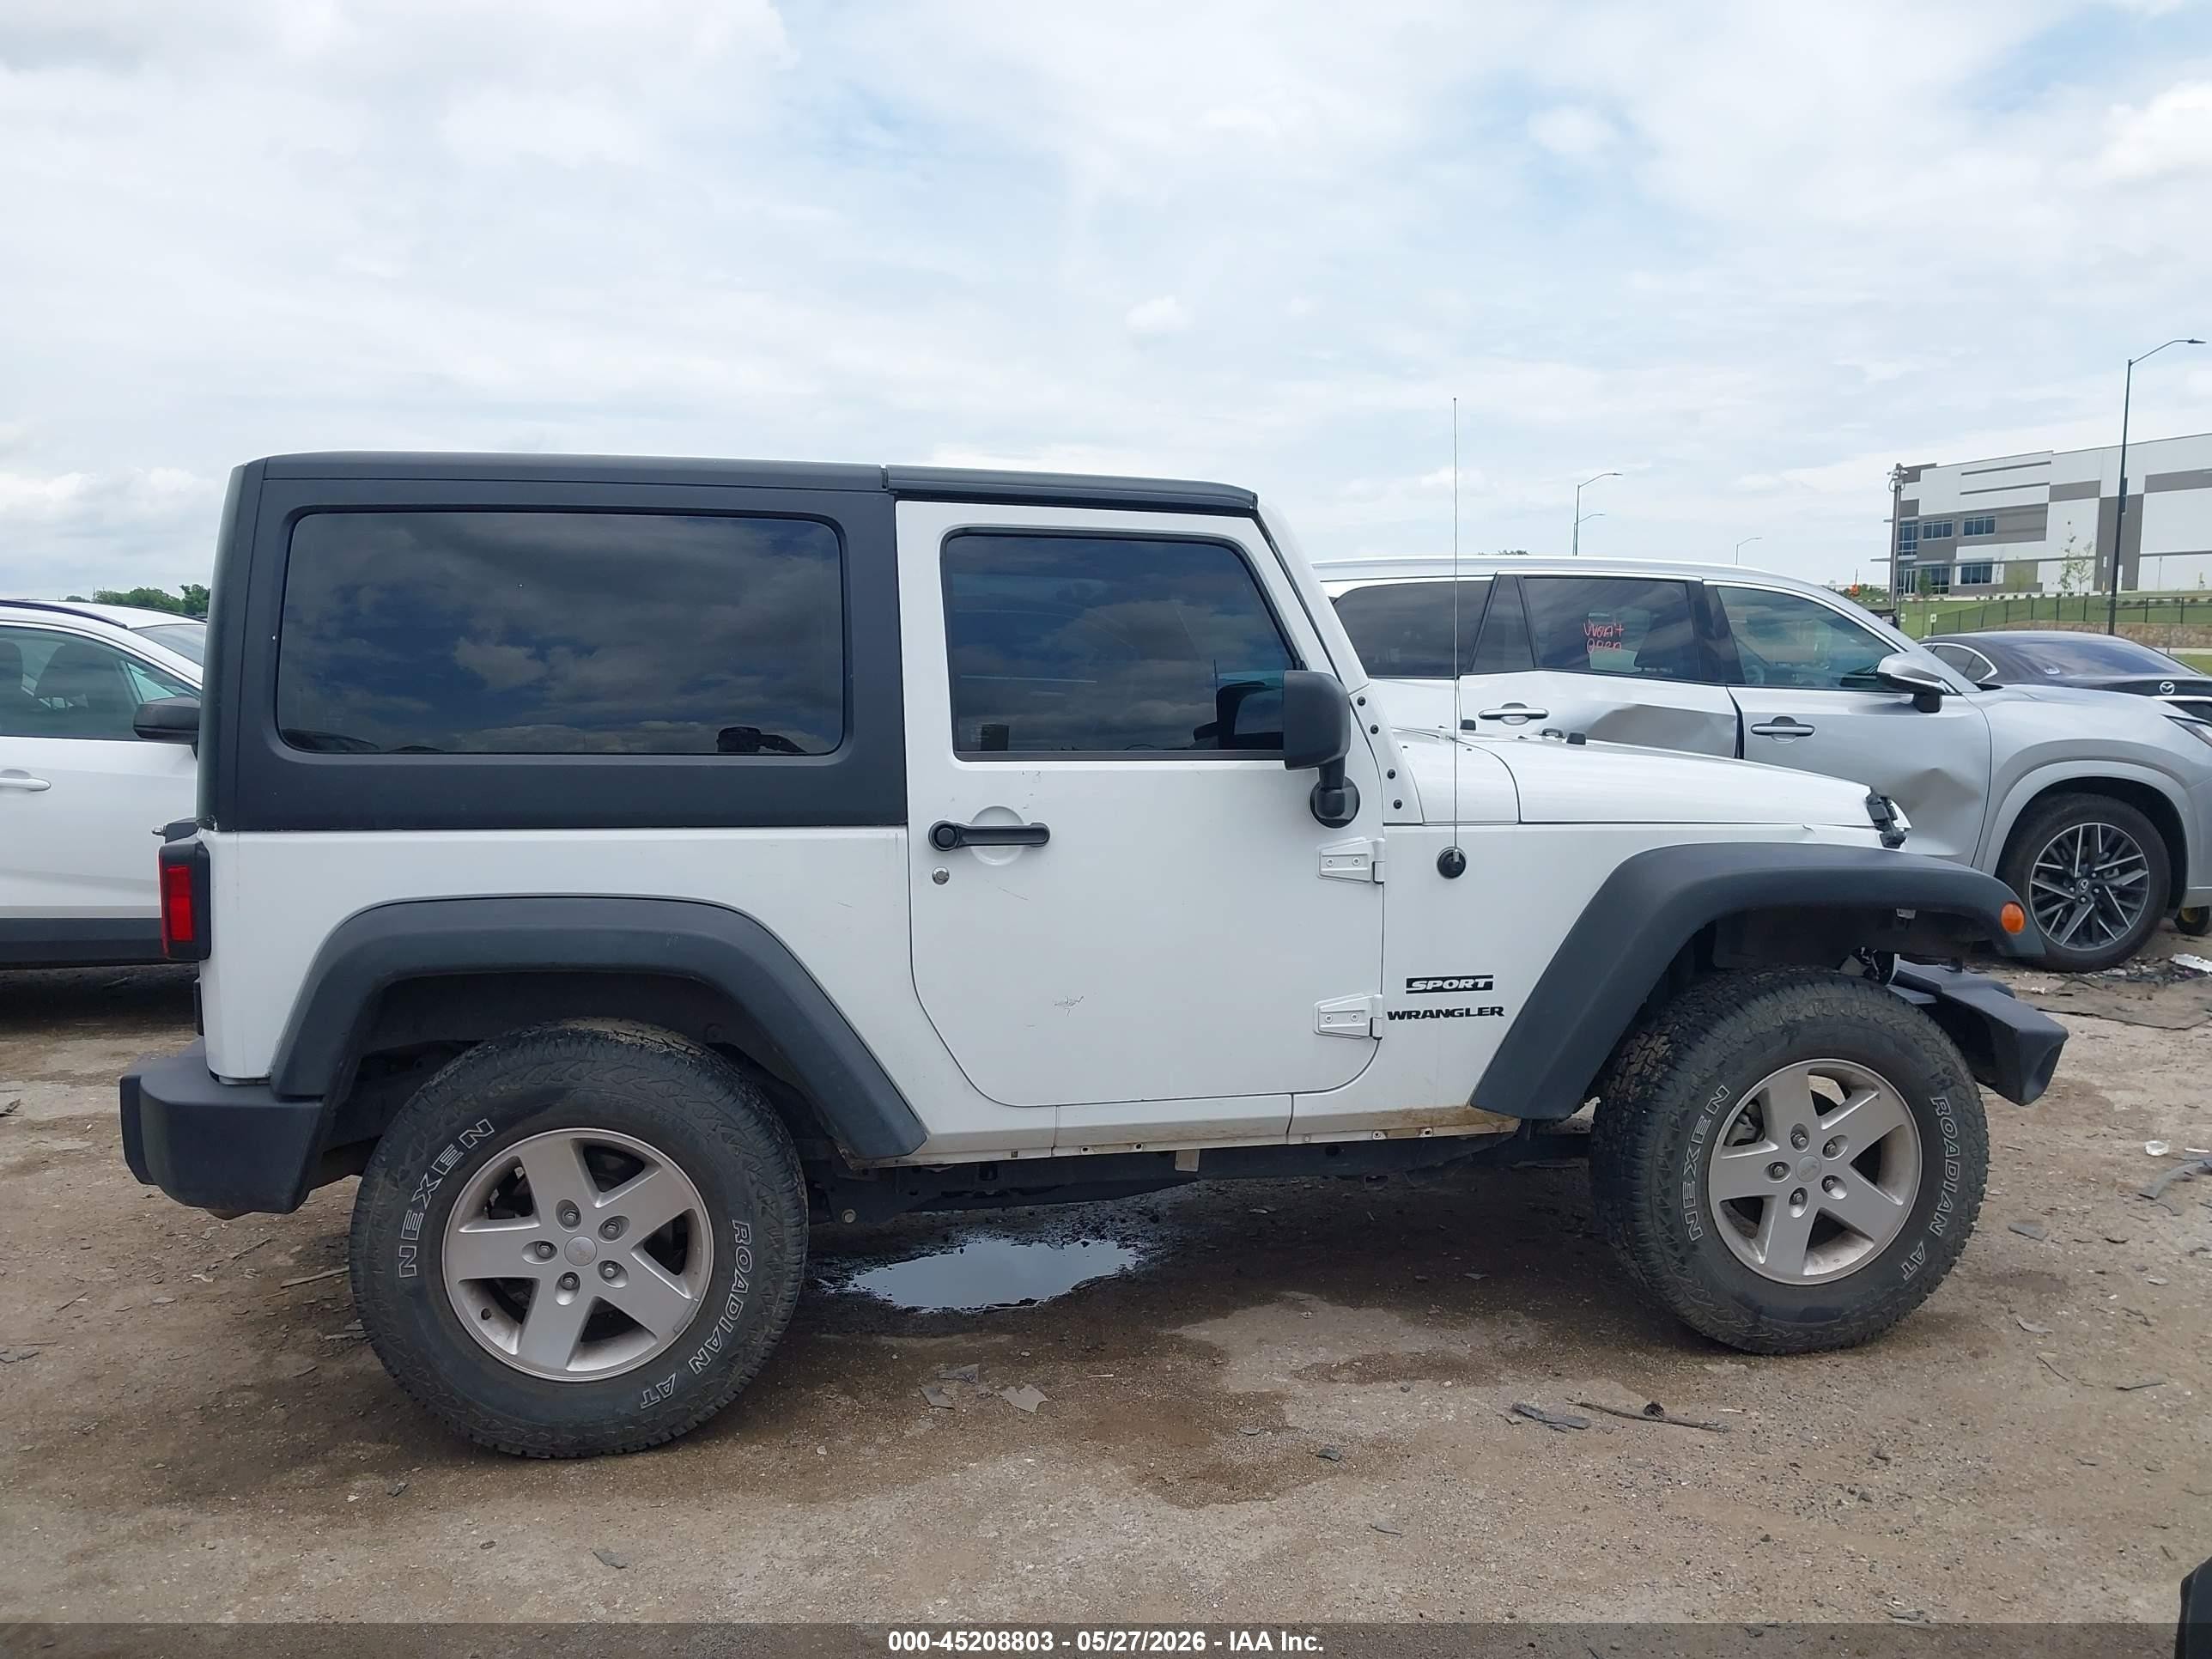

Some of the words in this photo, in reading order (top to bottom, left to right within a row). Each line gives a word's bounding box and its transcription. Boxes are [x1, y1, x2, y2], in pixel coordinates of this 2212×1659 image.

[1387, 1006, 1504, 1021] WRANGLER
[1406, 977, 1494, 991] SPORT
[398, 1118, 495, 1279] NEXEN
[1681, 1085, 1731, 1242] NEXEN
[1929, 1096, 1961, 1237] ROADIAN
[688, 1219, 753, 1375] ROADIAN
[1900, 1241, 1926, 1281] AT
[640, 1372, 677, 1409] AT
